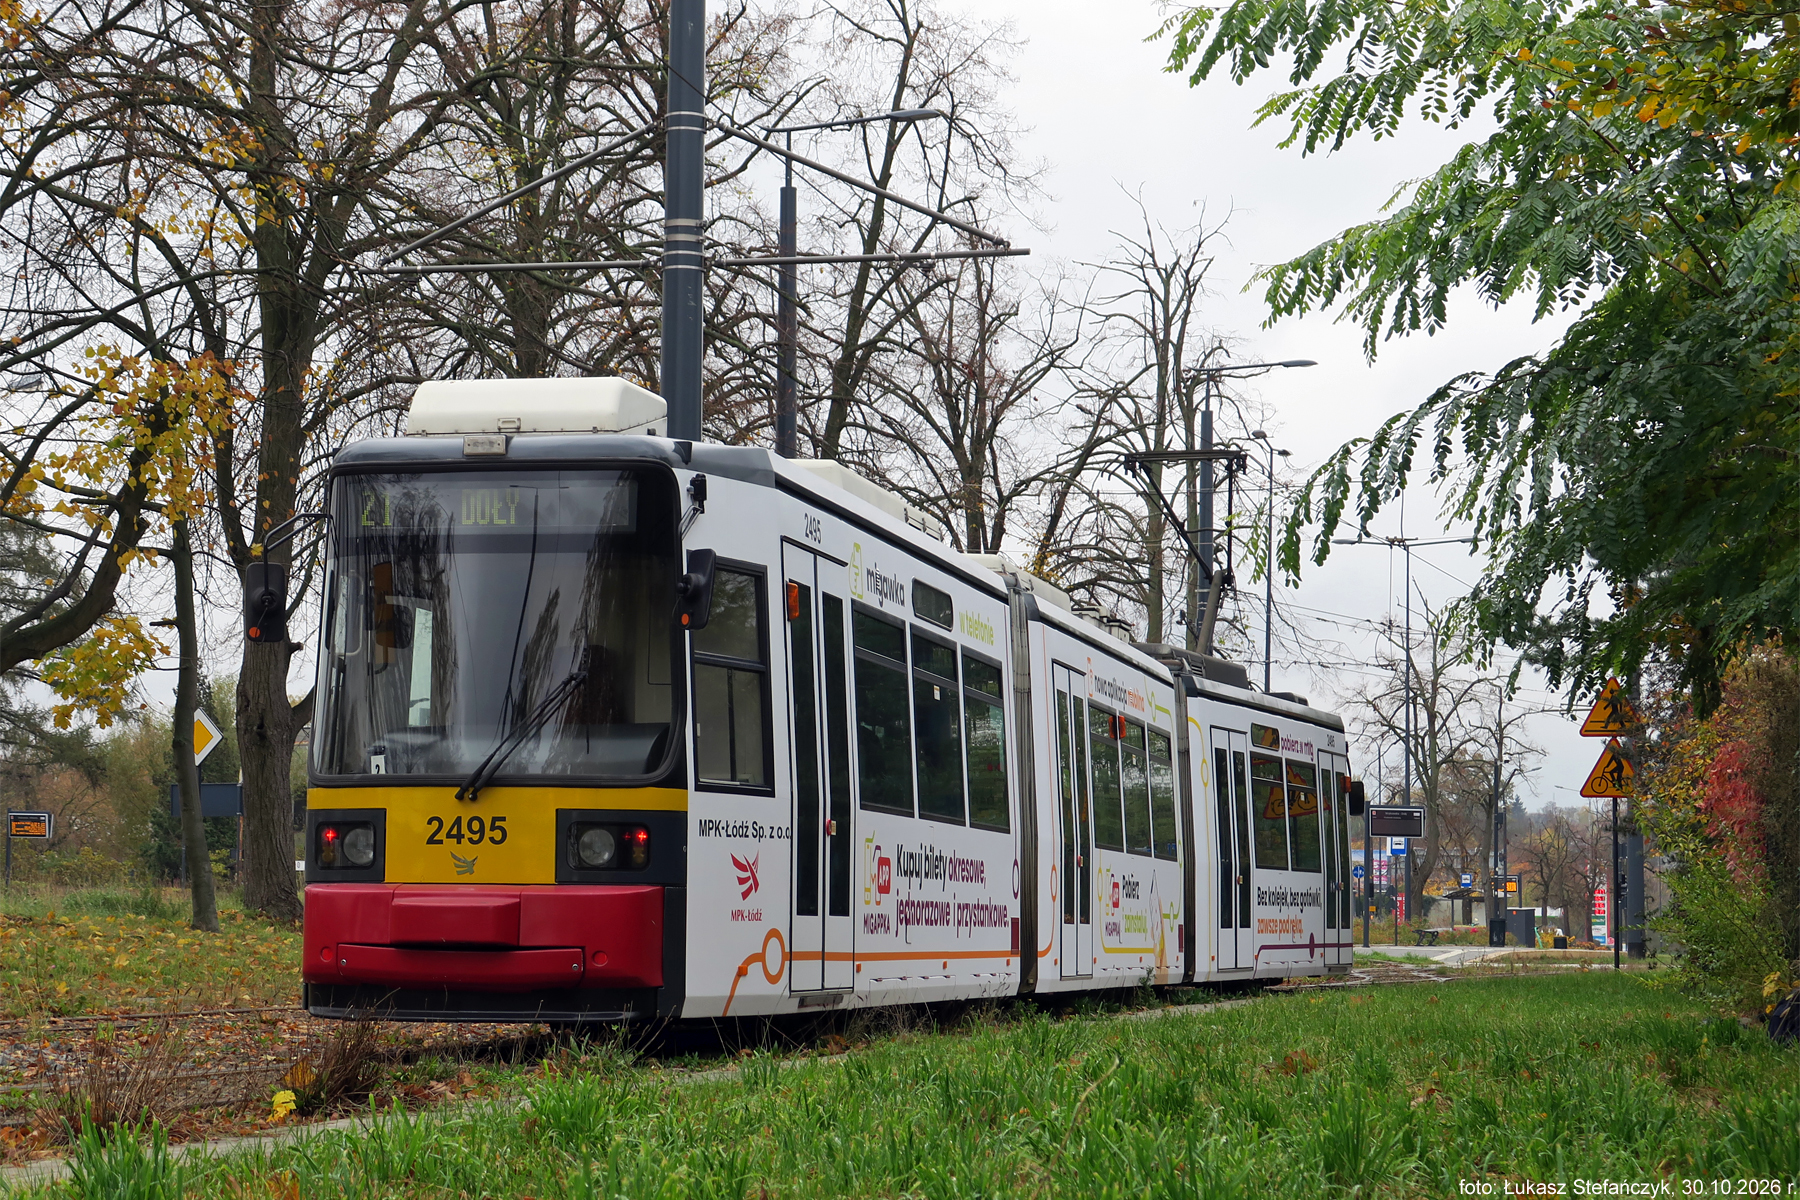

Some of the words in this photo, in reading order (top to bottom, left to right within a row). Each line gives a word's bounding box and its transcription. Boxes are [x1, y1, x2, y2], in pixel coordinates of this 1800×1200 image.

[804, 512, 822, 544] 2495
[866, 562, 905, 608] migawka
[959, 611, 965, 634] w
[965, 610, 994, 646] telefonie
[1094, 675, 1107, 697] nowa
[1107, 677, 1127, 711] aplikacja
[425, 816, 508, 846] 2495
[699, 819, 749, 838] MPK-Łódź
[752, 820, 767, 843] Sp.
[769, 826, 775, 839] z
[878, 865, 889, 887] APP
[896, 843, 923, 890] Kupuj
[924, 844, 947, 892] bilety
[948, 849, 986, 889] okresowe,
[1122, 873, 1139, 900] Pobierz
[1257, 886, 1267, 906] Bez
[1268, 885, 1289, 913] kolejek,
[1290, 887, 1299, 907] bez
[731, 908, 762, 921] MPK-Łódź
[863, 913, 890, 934] MIGAPPKA
[895, 888, 950, 937] jednorazowe
[957, 897, 1009, 938] przystankowe.
[1257, 918, 1278, 934] zawsze
[1279, 914, 1290, 941] pod
